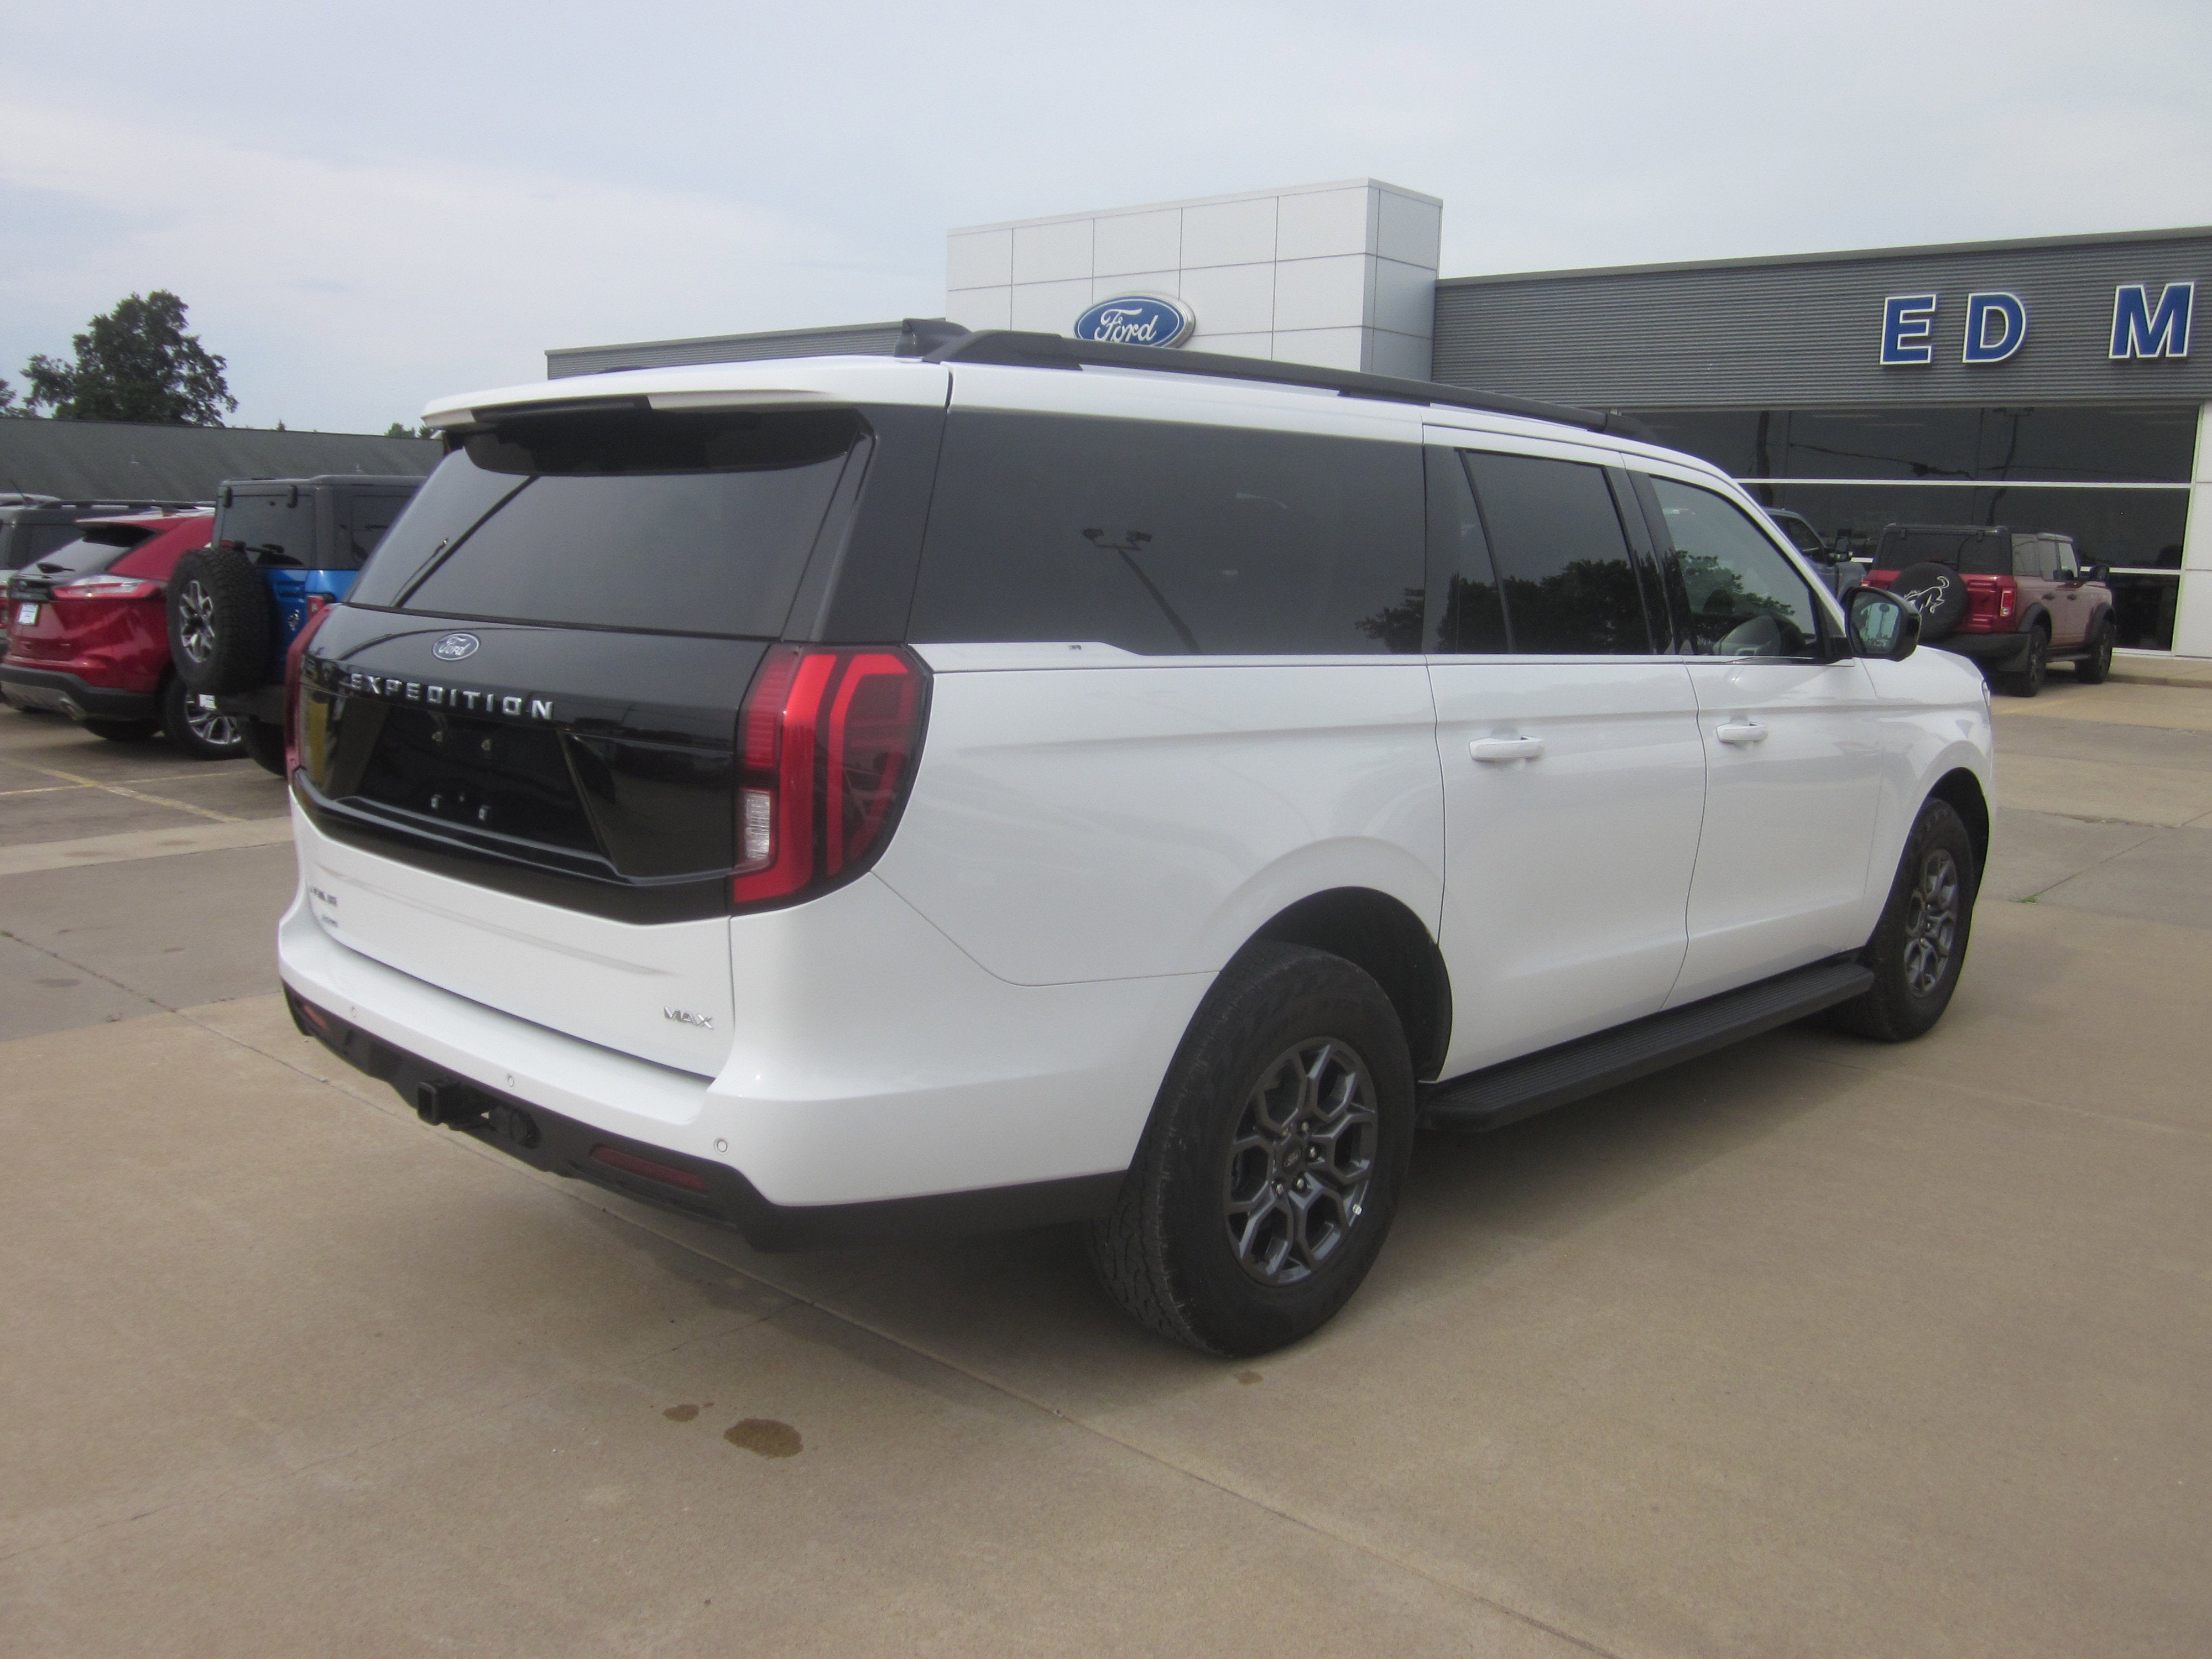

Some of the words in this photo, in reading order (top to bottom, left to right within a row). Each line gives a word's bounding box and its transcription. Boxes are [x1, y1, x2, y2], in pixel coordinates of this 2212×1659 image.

[1094, 307, 1159, 342] Ford
[437, 636, 471, 656] Ford
[349, 672, 554, 719] EXPEDITION
[663, 1006, 714, 1030] MAX
